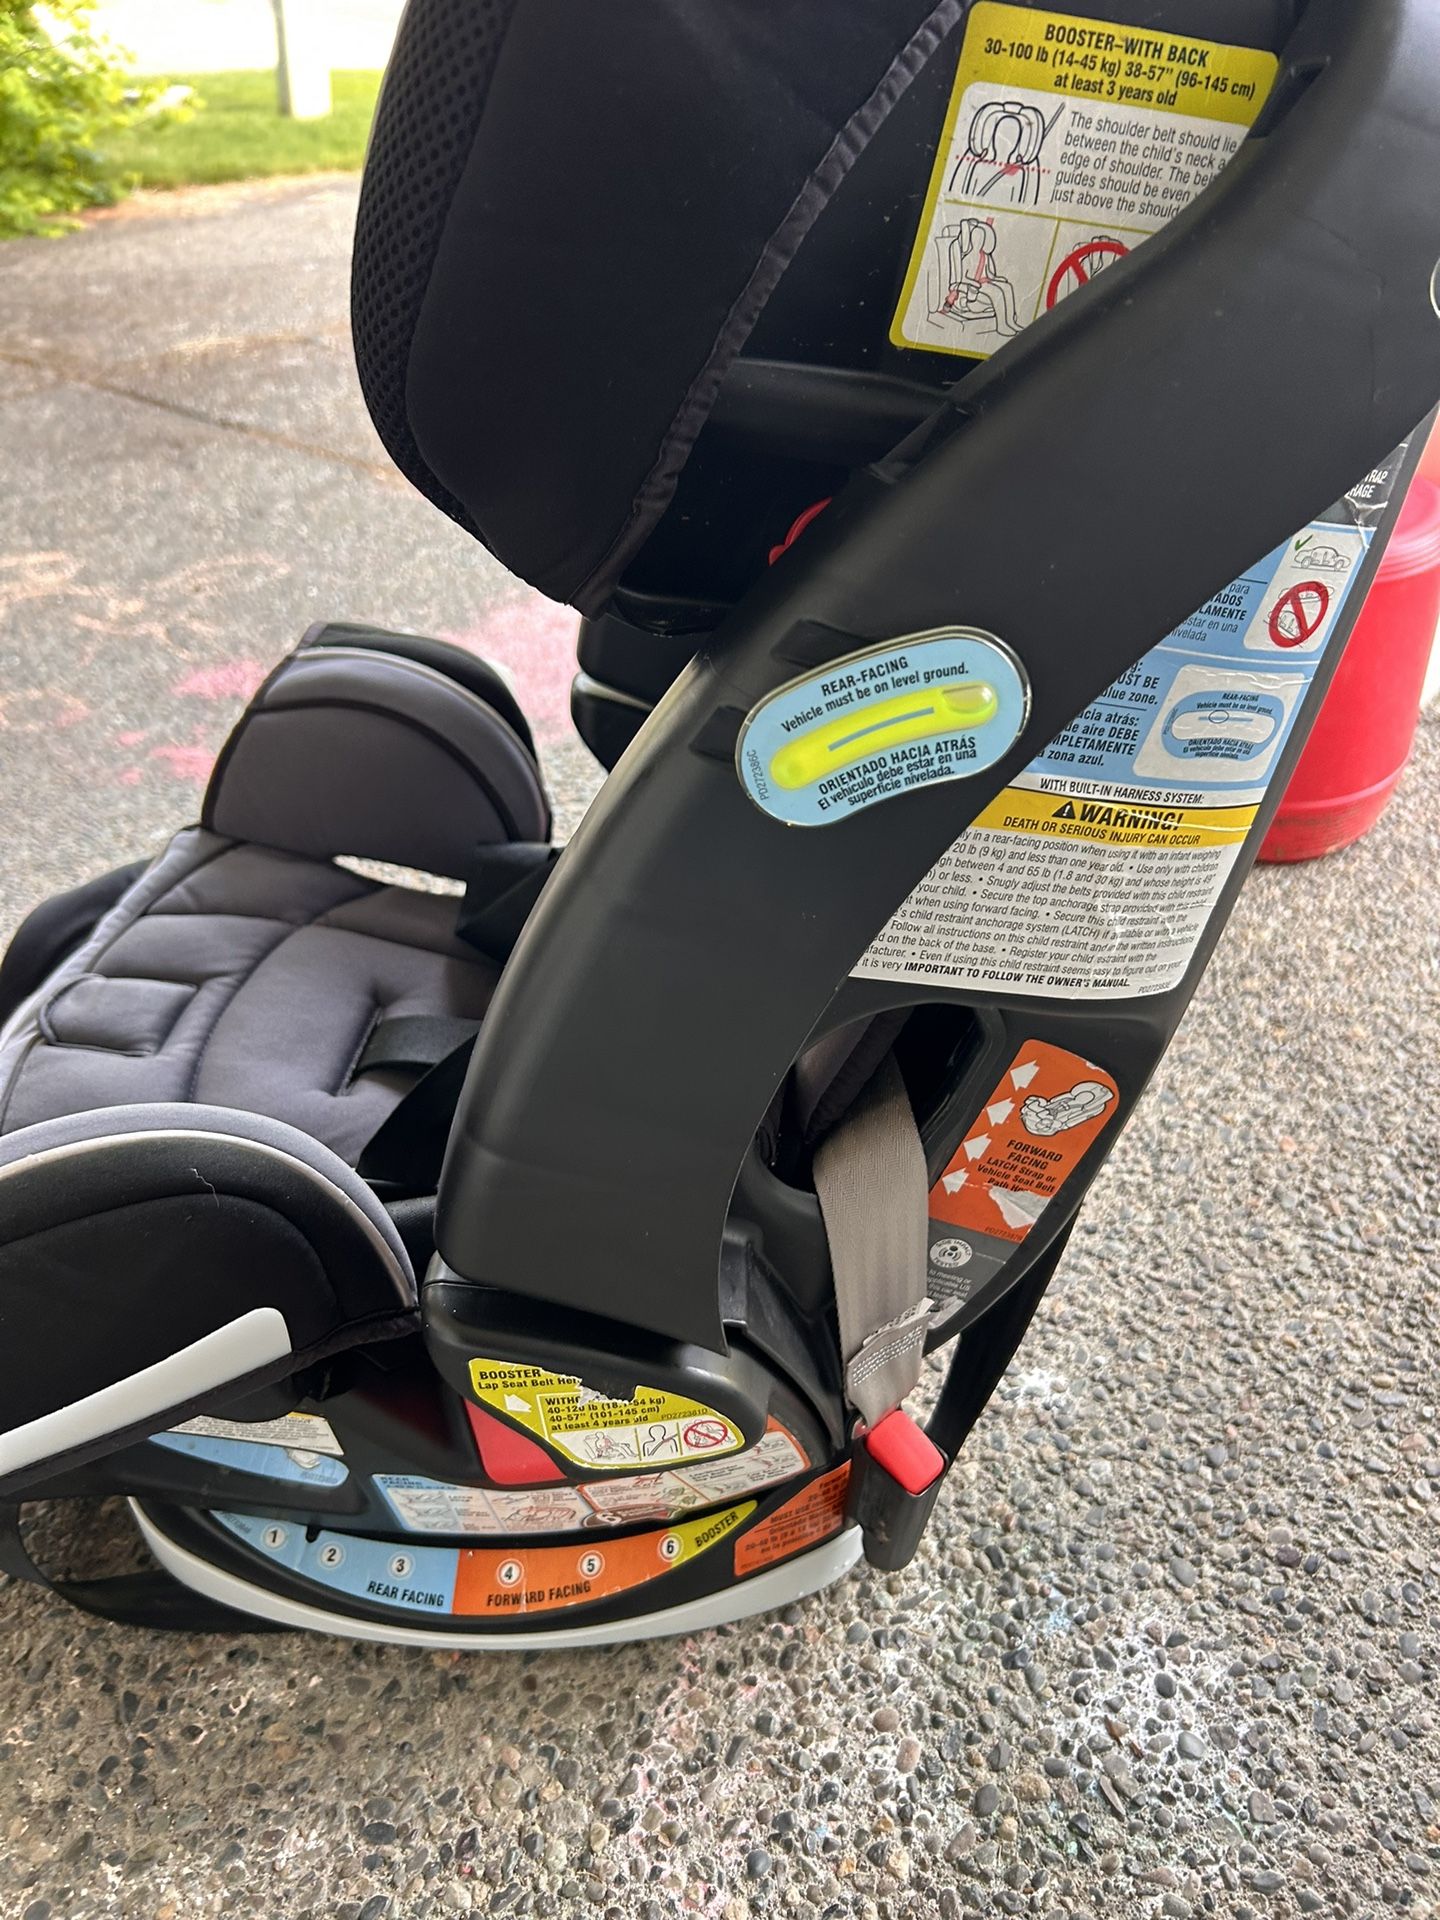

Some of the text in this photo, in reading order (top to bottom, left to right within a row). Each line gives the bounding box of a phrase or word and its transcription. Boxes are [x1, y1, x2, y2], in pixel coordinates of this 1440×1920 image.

[1167, 46, 1209, 67] BACK
[985, 38, 1032, 60] 30-100
[1036, 46, 1049, 62] lb
[1052, 49, 1097, 70] (14-45
[1101, 56, 1121, 77] kg)
[1176, 70, 1228, 92] (96-145
[1231, 81, 1255, 100] cm)
[1054, 74, 1178, 106] at least 3 years old
[1071, 111, 1237, 153] The shoulder belt should lie
[1065, 132, 1116, 151] between
[1120, 139, 1138, 156] the
[1142, 145, 1182, 164] child's
[1186, 152, 1218, 169] neck
[1060, 151, 1215, 186] edge of shoulder. The bel
[1056, 169, 1190, 203] guides should be even
[1050, 187, 1181, 218] just above the should
[1229, 583, 1250, 594] para
[1213, 593, 1243, 606] ADOS
[1207, 621, 1219, 630] en
[1221, 623, 1238, 633] una
[821, 656, 909, 696] REAR-FACING
[1142, 677, 1160, 689] BE
[780, 662, 969, 733] Vehicle must be on level ground.
[1128, 692, 1158, 705] zone.
[1105, 713, 1139, 727] atrás:
[1082, 724, 1105, 736] aire
[1108, 726, 1140, 741] DEBE
[818, 736, 977, 795] ORIENTADO HACIA ATRÁS
[1048, 750, 1104, 766] zona azul.
[817, 748, 977, 811] El vehículo debe estar en una
[847, 765, 955, 806] superficie nivelada.
[1040, 778, 1204, 804] WITH BUILT-IN HARNESS SYSTEM:
[1080, 803, 1184, 830] WARNING!
[1004, 817, 1200, 844] DEATH OR SERIOUS INJURY CAN OCCUR
[992, 834, 1106, 858] rear-facing position when
[955, 858, 995, 872] between
[987, 876, 1050, 892] Snugly adjust
[981, 889, 1098, 912] Secure top anchorage
[891, 920, 991, 940] Follow instructions
[1025, 922, 1099, 939] system (LATCH)
[882, 961, 902, 971] very
[904, 962, 964, 976] IMPORTANT
[966, 968, 979, 978] TO
[982, 969, 1023, 981] FOLLOW
[1025, 974, 1045, 984] THE
[1046, 976, 1089, 987] OWNER'S
[1092, 979, 1129, 988] MANUAL.
[1007, 1139, 1063, 1161] FORWARD
[1007, 1152, 1048, 1169] FACING
[977, 1164, 1055, 1192] Vehicle Seat Belt
[987, 1157, 1018, 1171] LATCH
[1019, 1167, 1044, 1180] Strap
[479, 1381, 498, 1390] Lap
[502, 1380, 528, 1388] Seat
[532, 1379, 553, 1387] Belt
[480, 1369, 541, 1380] BOOSTER
[548, 1406, 584, 1414] 40-120
[649, 1396, 665, 1405] kg)
[590, 1409, 637, 1420] (101-145
[641, 1406, 660, 1414] cm)
[564, 1421, 590, 1429] least
[602, 1418, 630, 1427] years
[270, 1529, 278, 1543] 1
[695, 1511, 739, 1547] BOOSTER
[327, 1548, 336, 1562] 2
[667, 1540, 674, 1553] 6
[396, 1559, 405, 1572] 3
[504, 1566, 513, 1580] 4
[586, 1558, 595, 1572] 5
[367, 1581, 444, 1607] REAR FACING
[486, 1581, 591, 1607] FORWARD FACING
